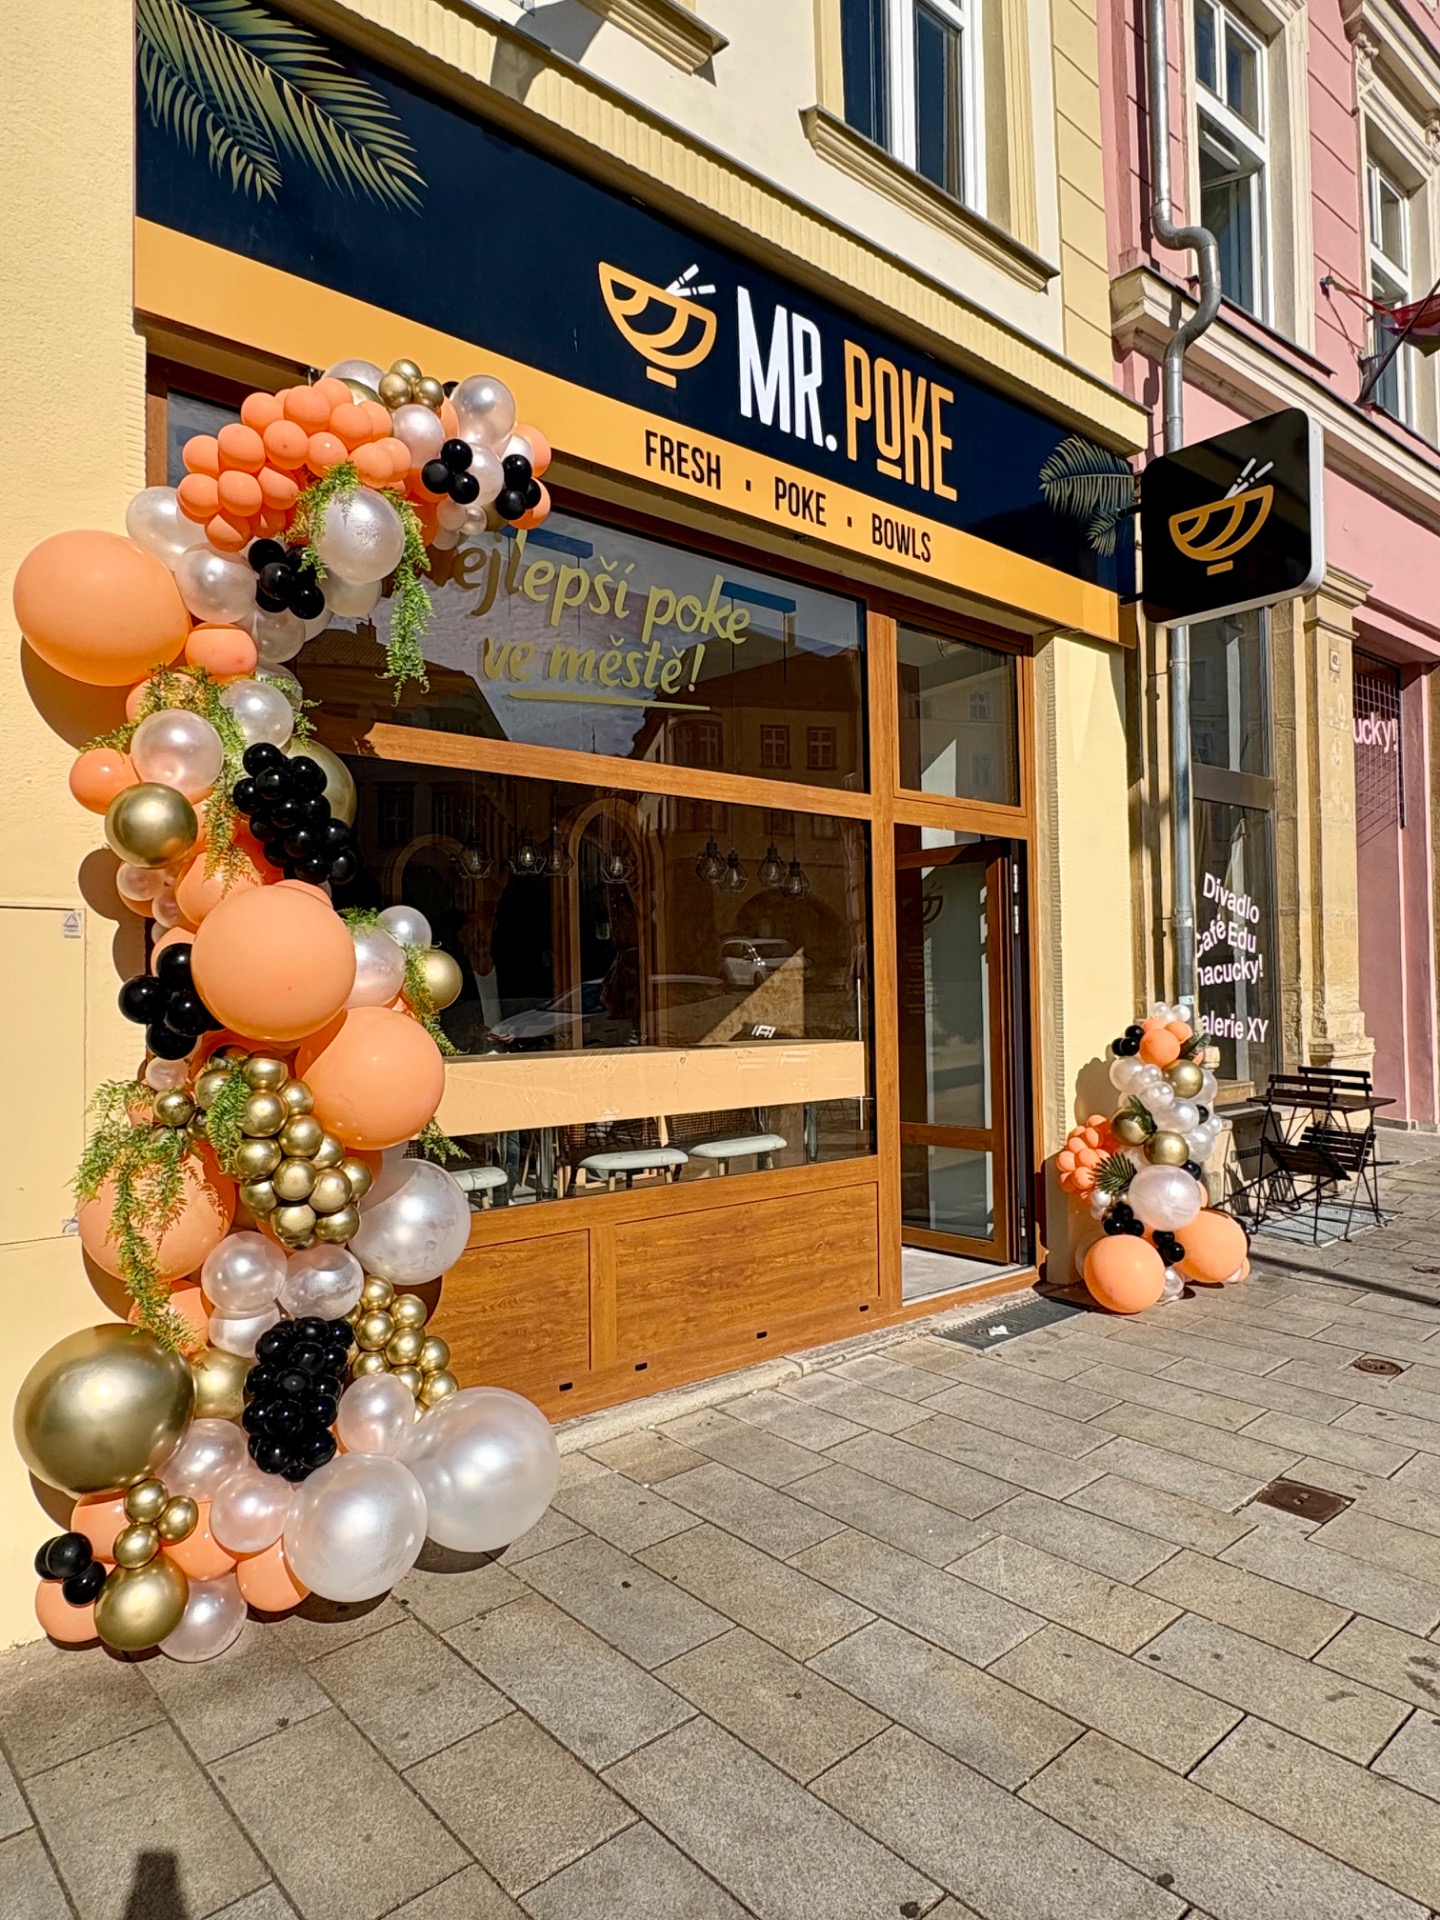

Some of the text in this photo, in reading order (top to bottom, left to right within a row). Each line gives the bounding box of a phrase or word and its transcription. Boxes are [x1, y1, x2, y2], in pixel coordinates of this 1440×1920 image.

[737, 286, 957, 502] MR. POKE
[645, 429, 931, 563] FRESH POKE BOWLS
[641, 574, 751, 645] poke
[483, 634, 707, 694] ve městě!
[1352, 712, 1398, 753] ucky!
[1202, 872, 1260, 924] Divadlo
[1227, 921, 1257, 954] Edu
[1196, 954, 1264, 986] nacucky!
[1200, 1010, 1269, 1043] alerie XY
